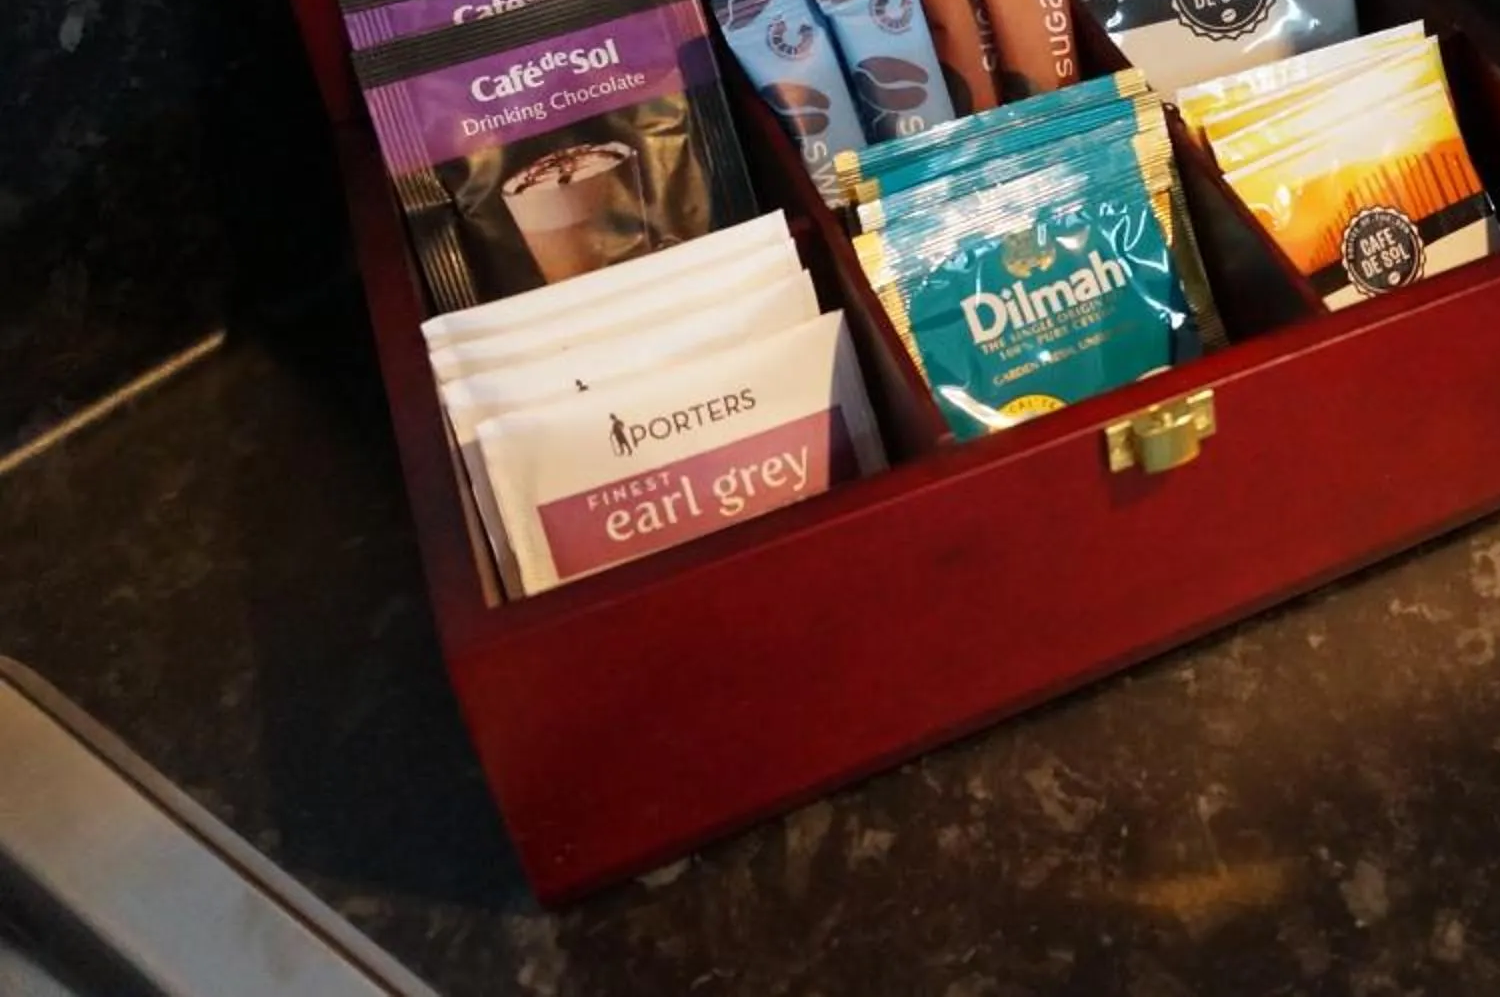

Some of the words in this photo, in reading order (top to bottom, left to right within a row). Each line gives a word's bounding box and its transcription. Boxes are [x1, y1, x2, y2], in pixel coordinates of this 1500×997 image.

[471, 59, 545, 102] Café
[539, 52, 569, 71] de
[568, 38, 620, 74] Sol
[461, 101, 547, 137] Drinking
[549, 72, 646, 110] Chocolate
[1360, 226, 1396, 256] CAFE
[1361, 255, 1383, 278] DE
[959, 250, 1127, 345] Dilmah
[629, 388, 757, 448] PORTERS
[586, 471, 672, 511] FINEST
[605, 475, 703, 541] earl
[712, 445, 808, 517] grey
